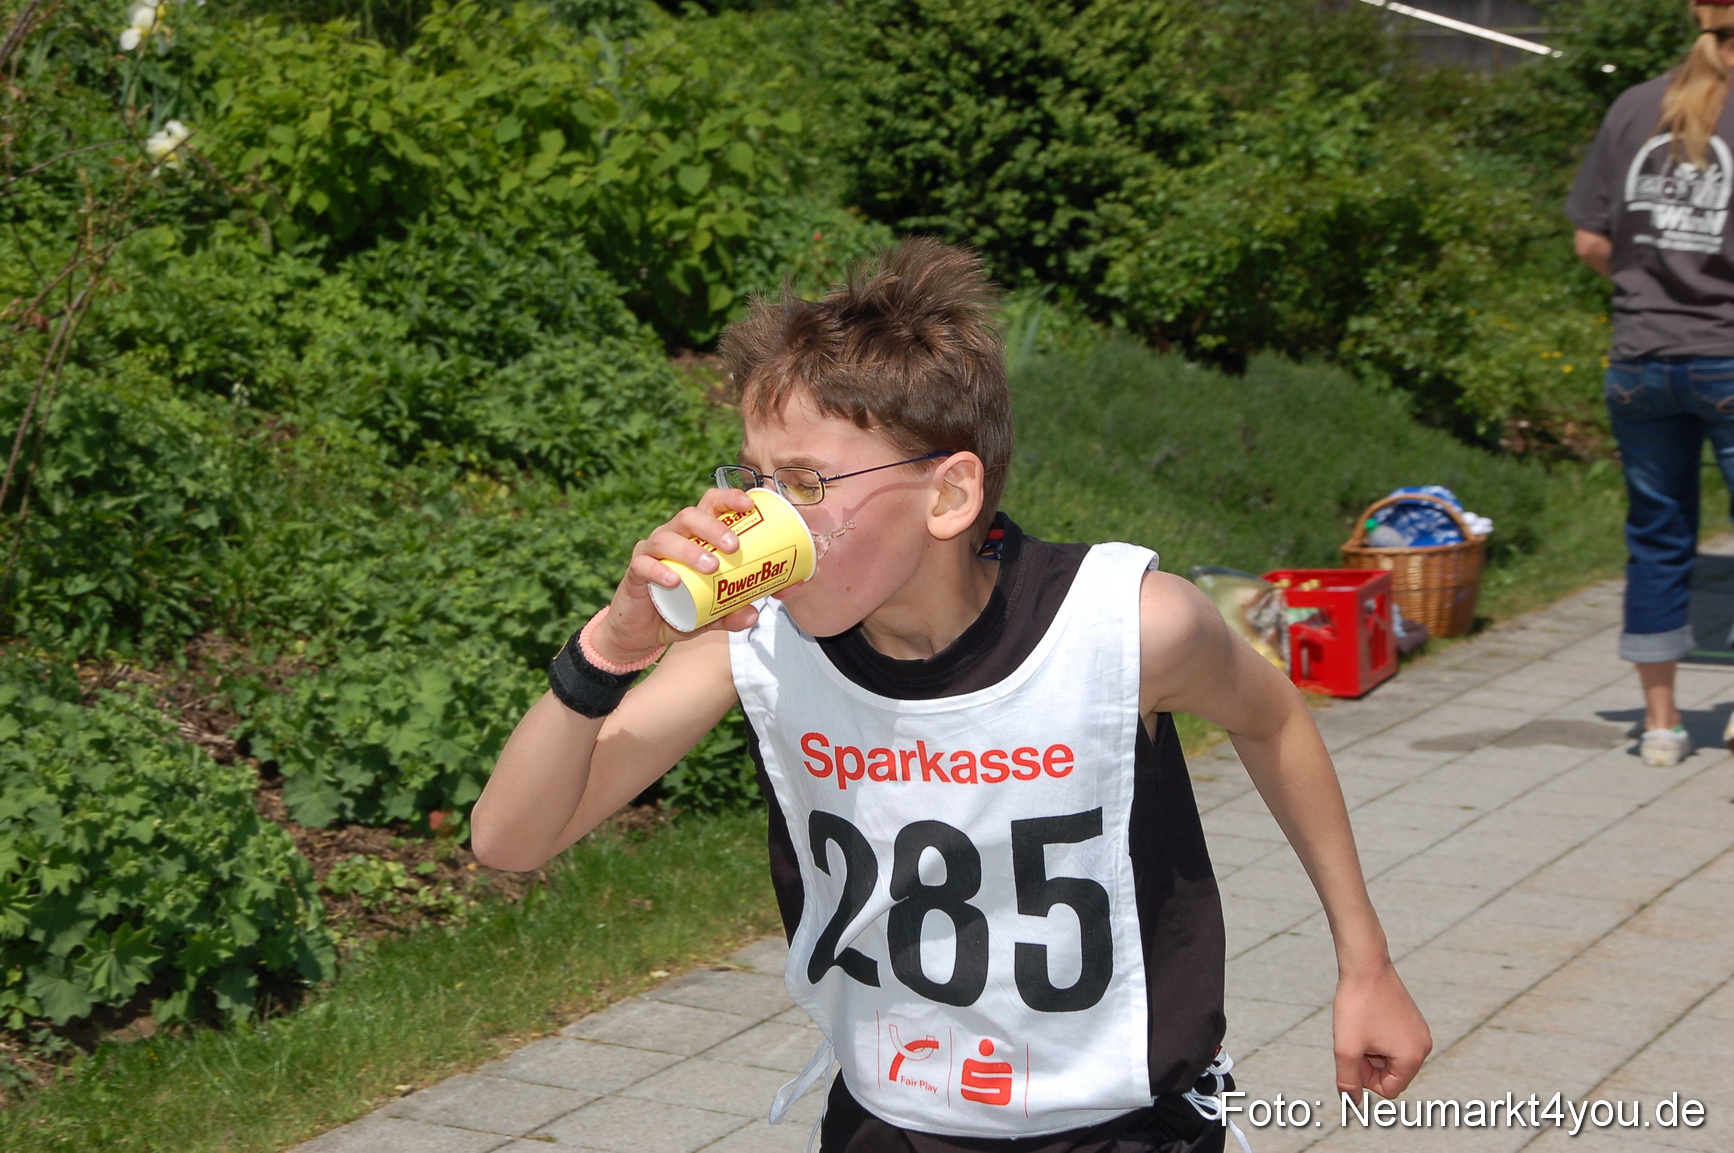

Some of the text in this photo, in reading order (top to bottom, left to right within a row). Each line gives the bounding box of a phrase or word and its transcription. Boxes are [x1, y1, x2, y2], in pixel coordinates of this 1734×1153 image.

[717, 560, 788, 601] PowerBar
[800, 732, 1075, 790] Sparkasse
[807, 806, 1114, 1012] 285
[901, 1075, 938, 1094] Fair Play
